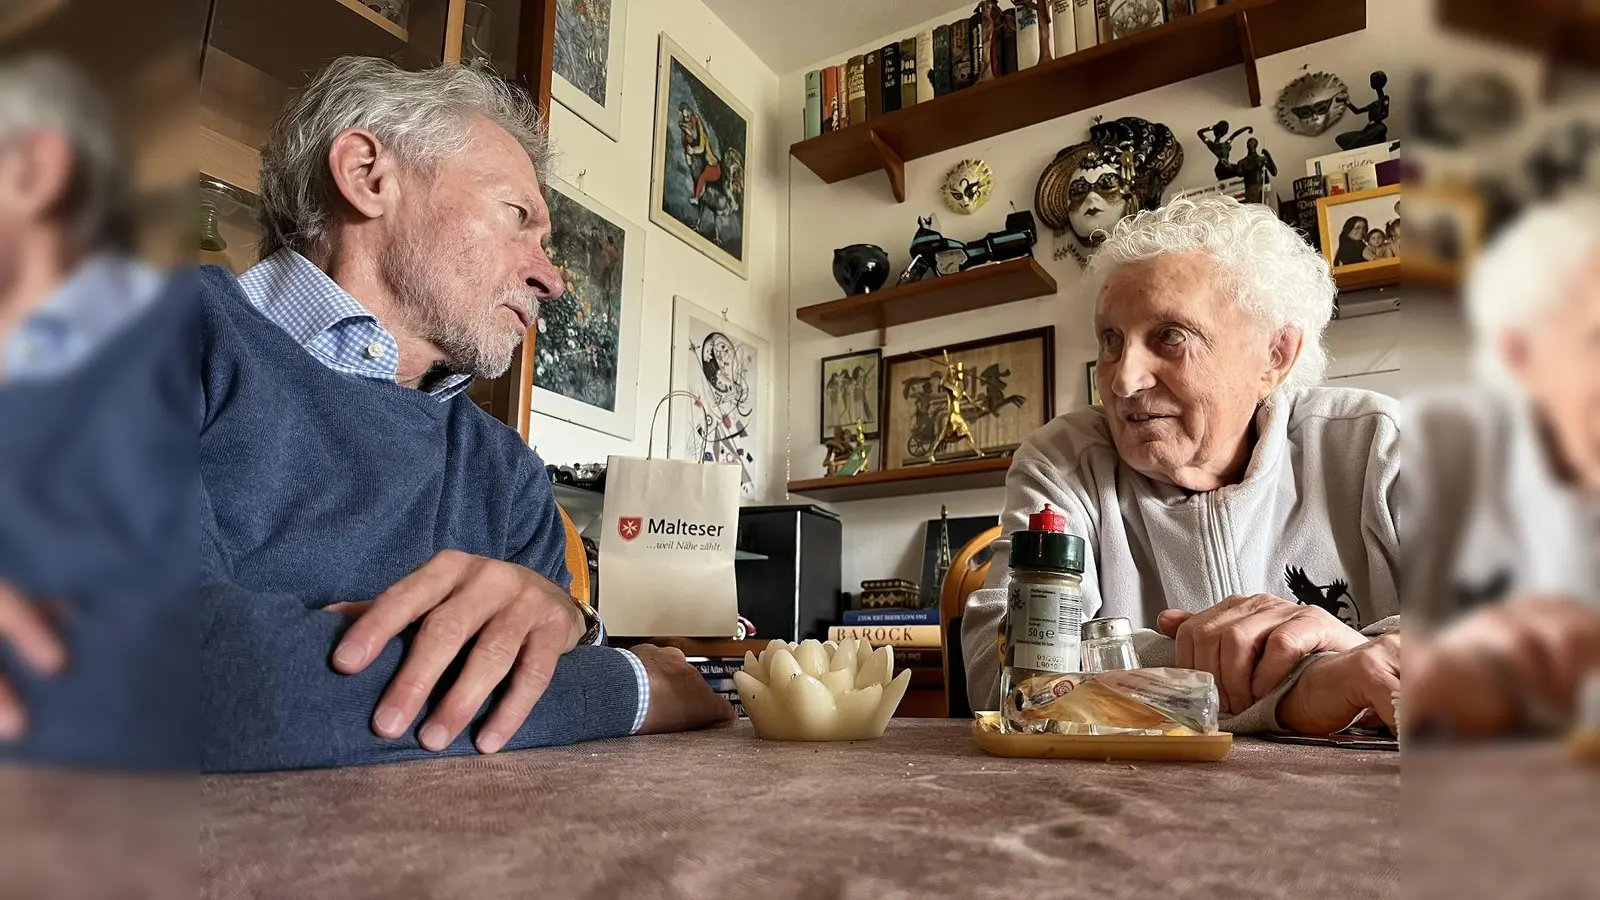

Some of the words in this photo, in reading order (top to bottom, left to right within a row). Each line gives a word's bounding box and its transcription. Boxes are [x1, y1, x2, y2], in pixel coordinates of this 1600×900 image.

[648, 518, 724, 537] Malteser
[675, 541, 698, 551] Nähe
[699, 541, 722, 551] zählt.
[837, 627, 913, 641] BAROCK
[1028, 627, 1038, 637] 50
[1038, 630, 1045, 640] g
[700, 665, 709, 674] Ski
[710, 665, 724, 674] Atlas
